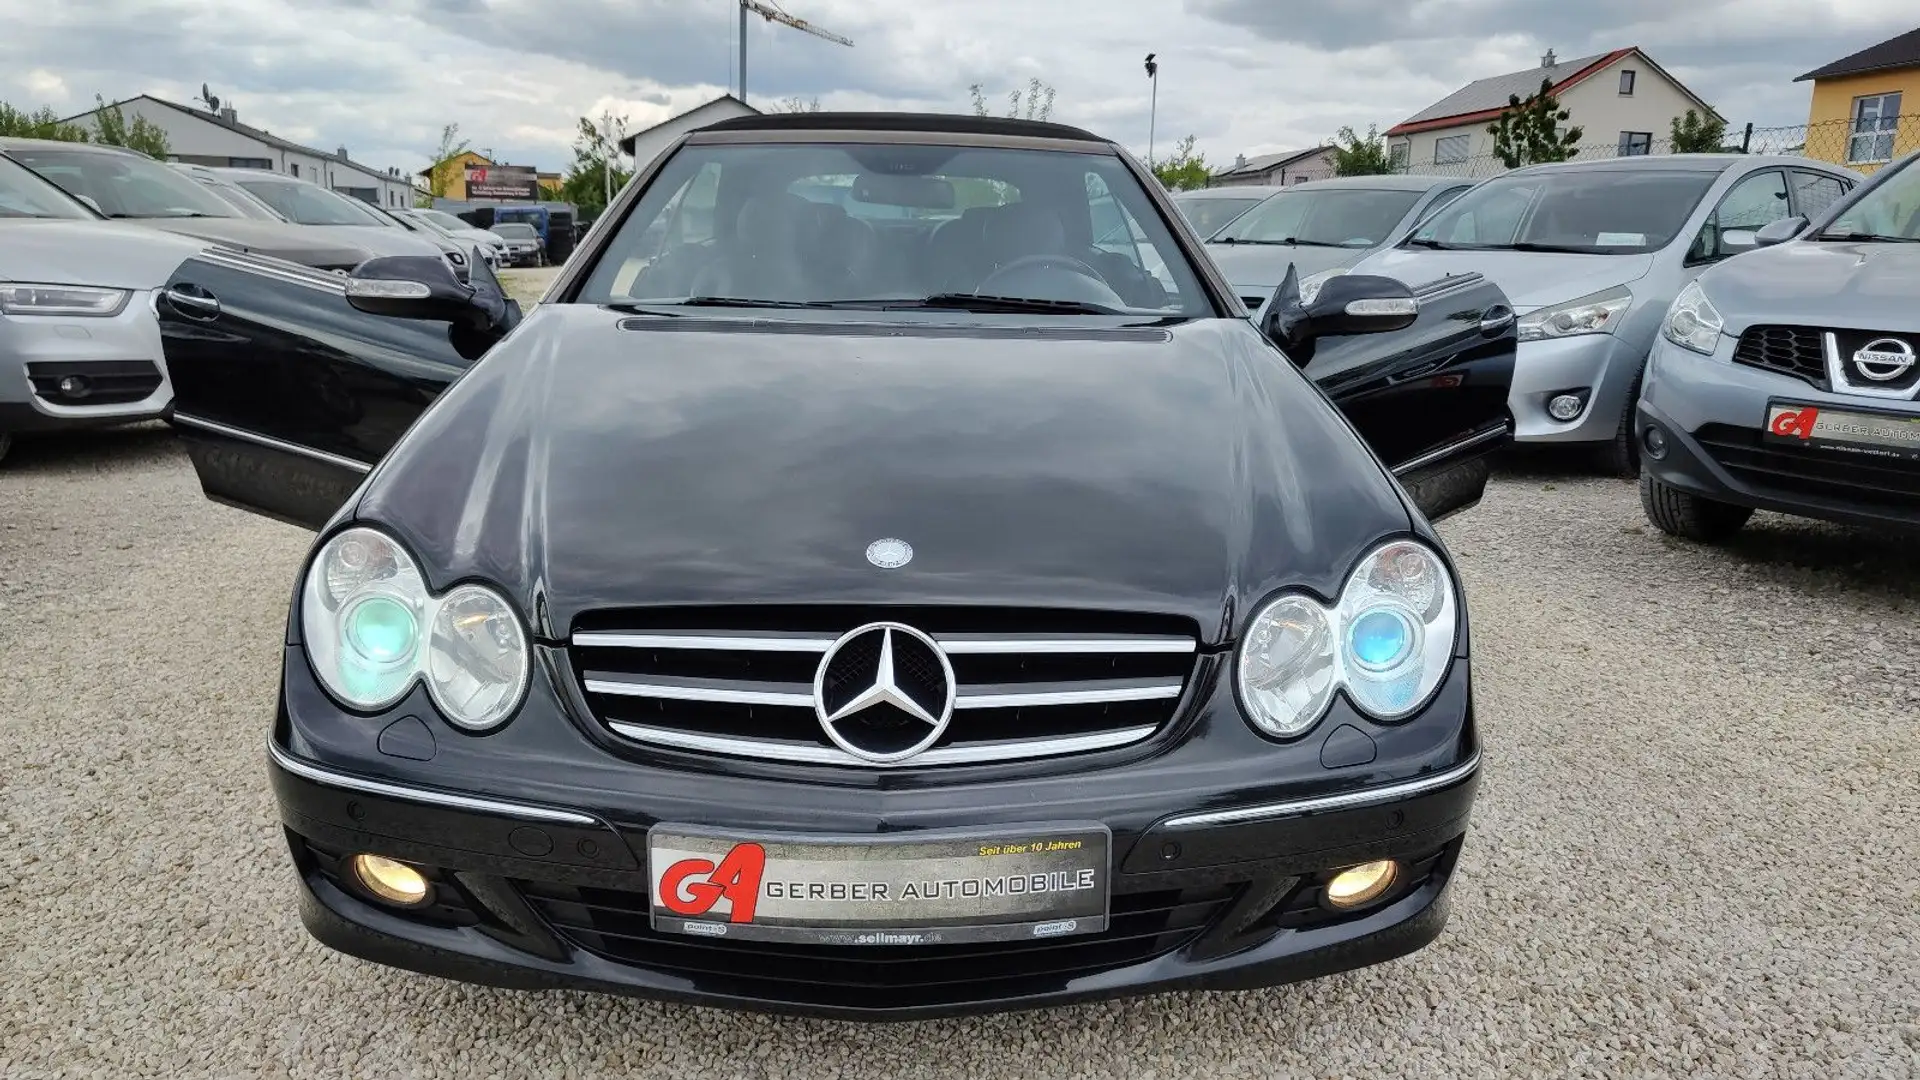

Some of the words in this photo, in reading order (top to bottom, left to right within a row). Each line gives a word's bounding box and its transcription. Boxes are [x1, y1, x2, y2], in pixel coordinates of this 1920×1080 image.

[1859, 352, 1908, 364] NISSAN
[1771, 407, 1819, 439] GA
[1815, 421, 1869, 436] GERBER
[979, 846, 1001, 856] Seit
[1003, 844, 1027, 854] über
[1031, 842, 1043, 852] 10
[1045, 840, 1082, 852] Jahren
[659, 842, 766, 923] GA
[765, 881, 892, 902] GERBER
[899, 868, 1095, 902] AUTOMOBILE
